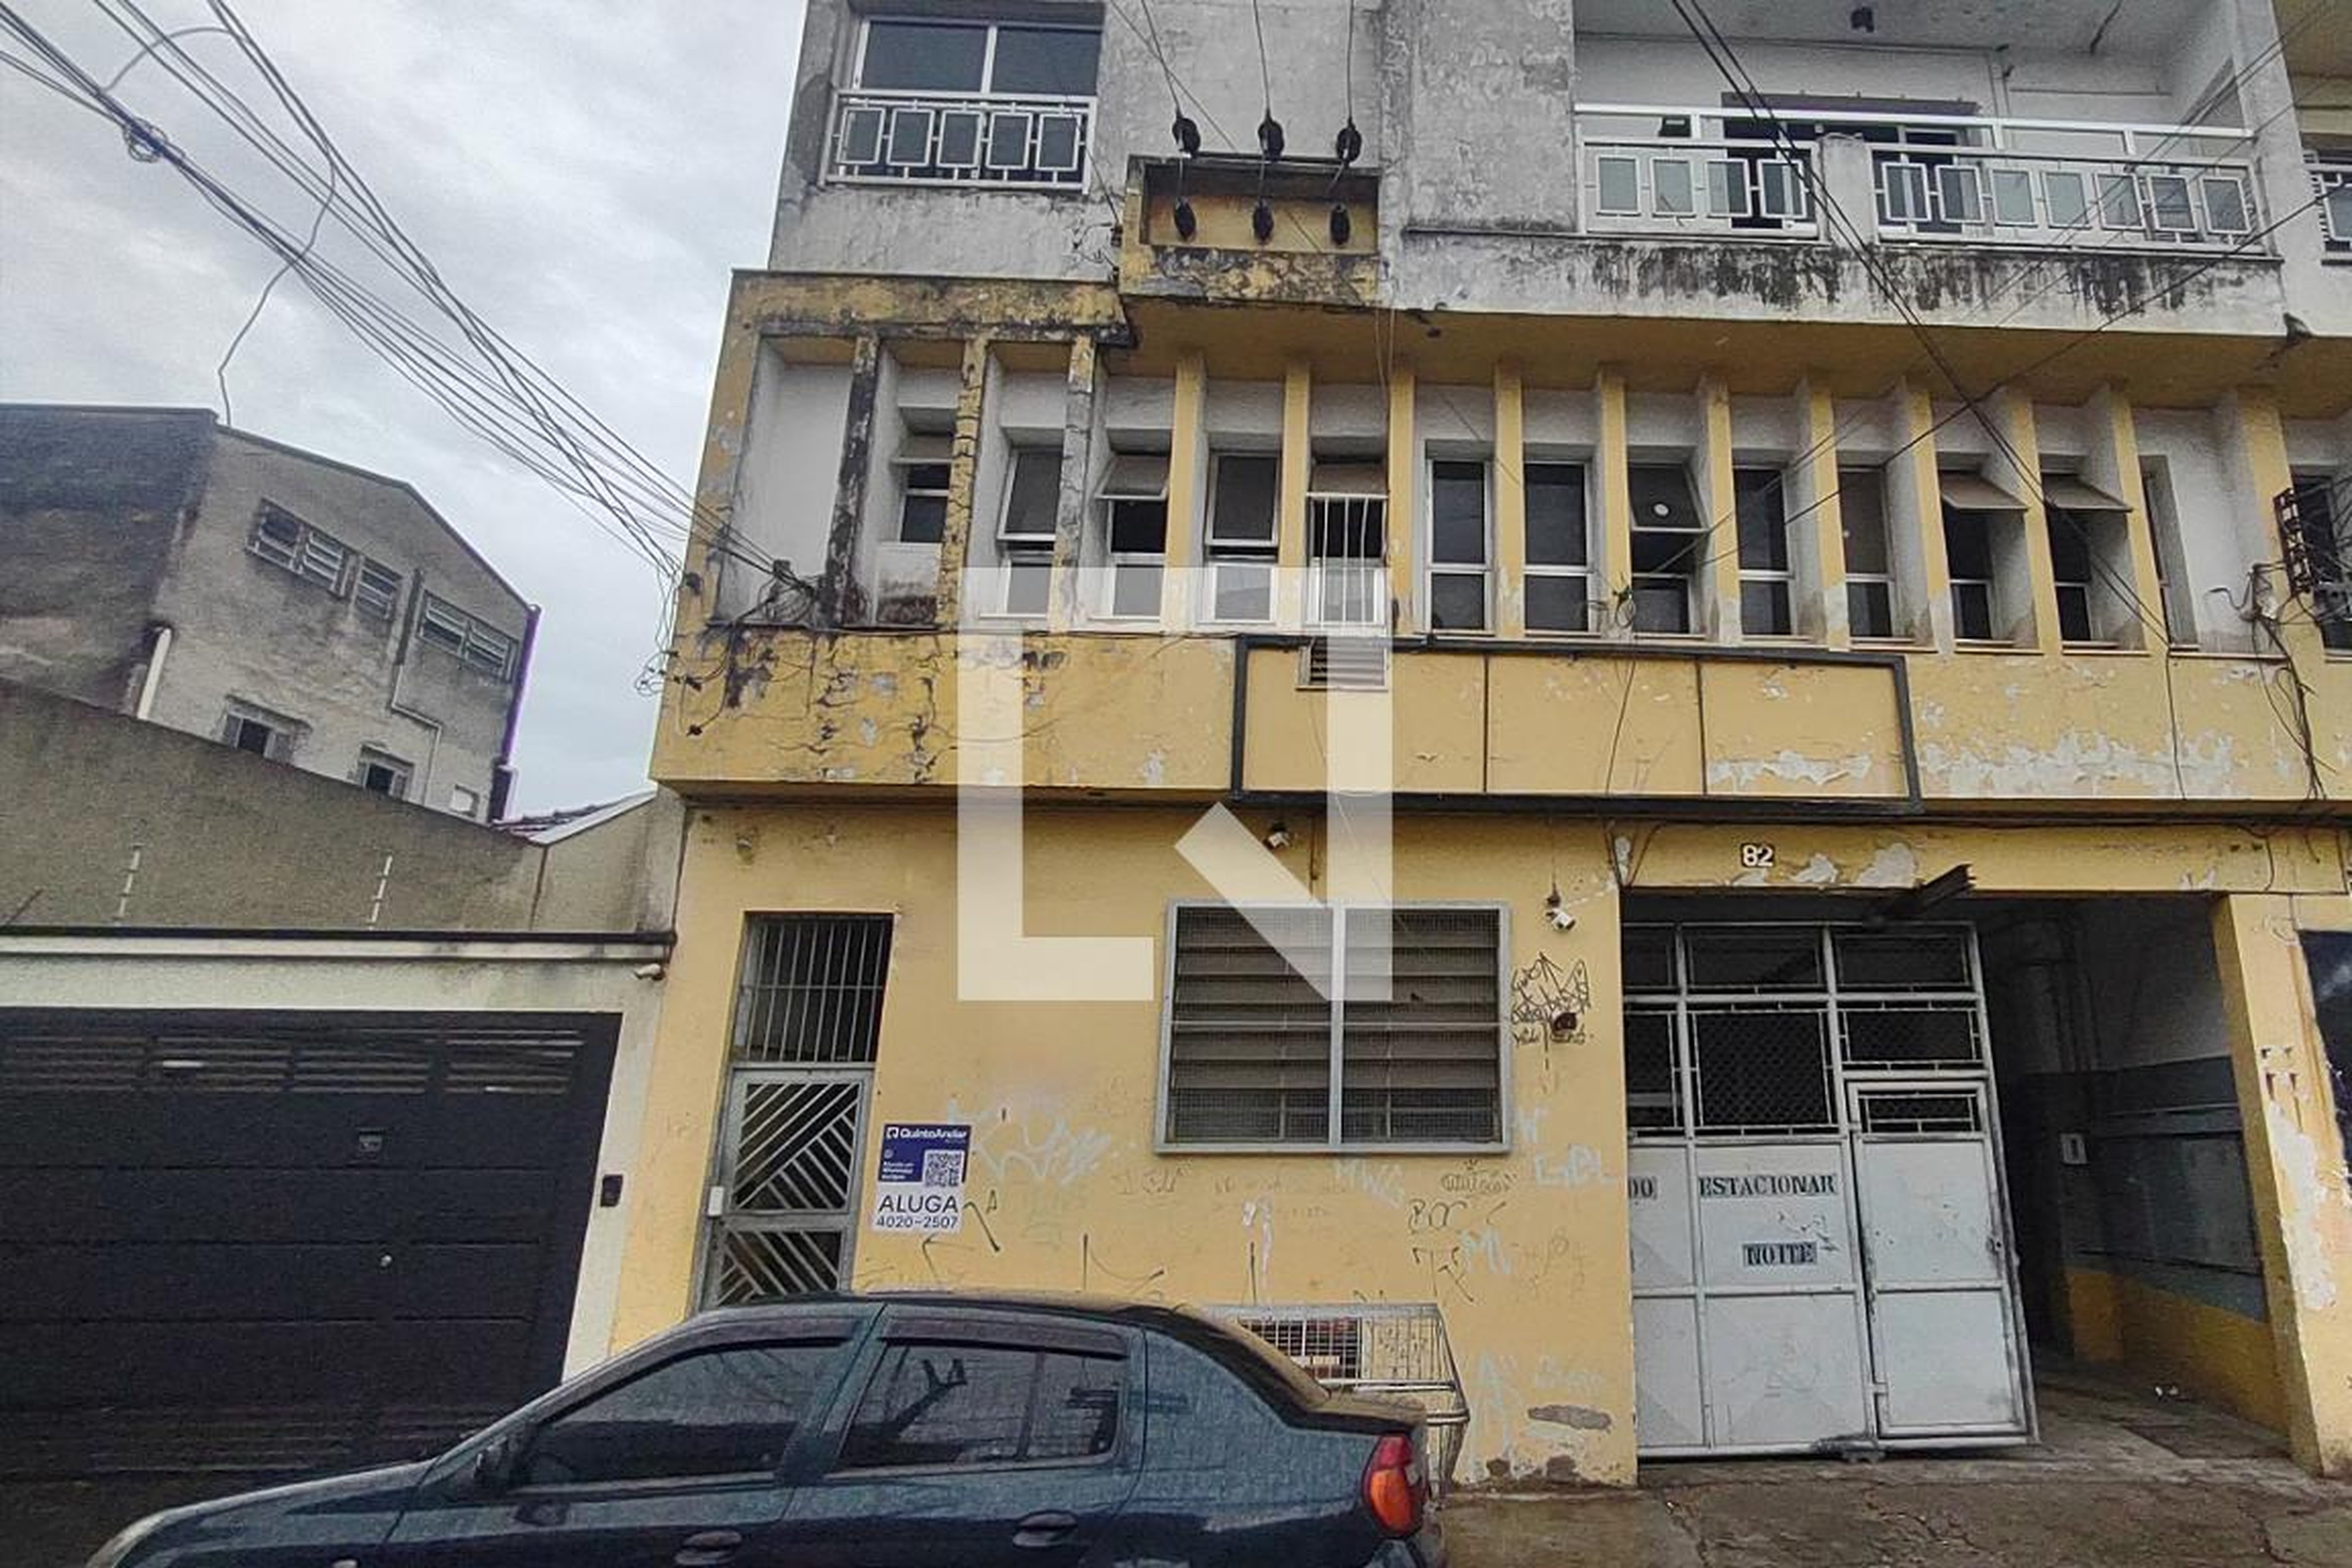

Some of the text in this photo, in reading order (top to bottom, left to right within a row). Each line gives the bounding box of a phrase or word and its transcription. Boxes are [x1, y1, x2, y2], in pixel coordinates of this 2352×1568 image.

[1742, 844, 1774, 867] 82
[1698, 1175, 1836, 1197] ESTACIONAR
[879, 1195, 958, 1213] ALUGA
[876, 1215, 958, 1228] 4020-2507
[1746, 1243, 1816, 1265] NOITE
